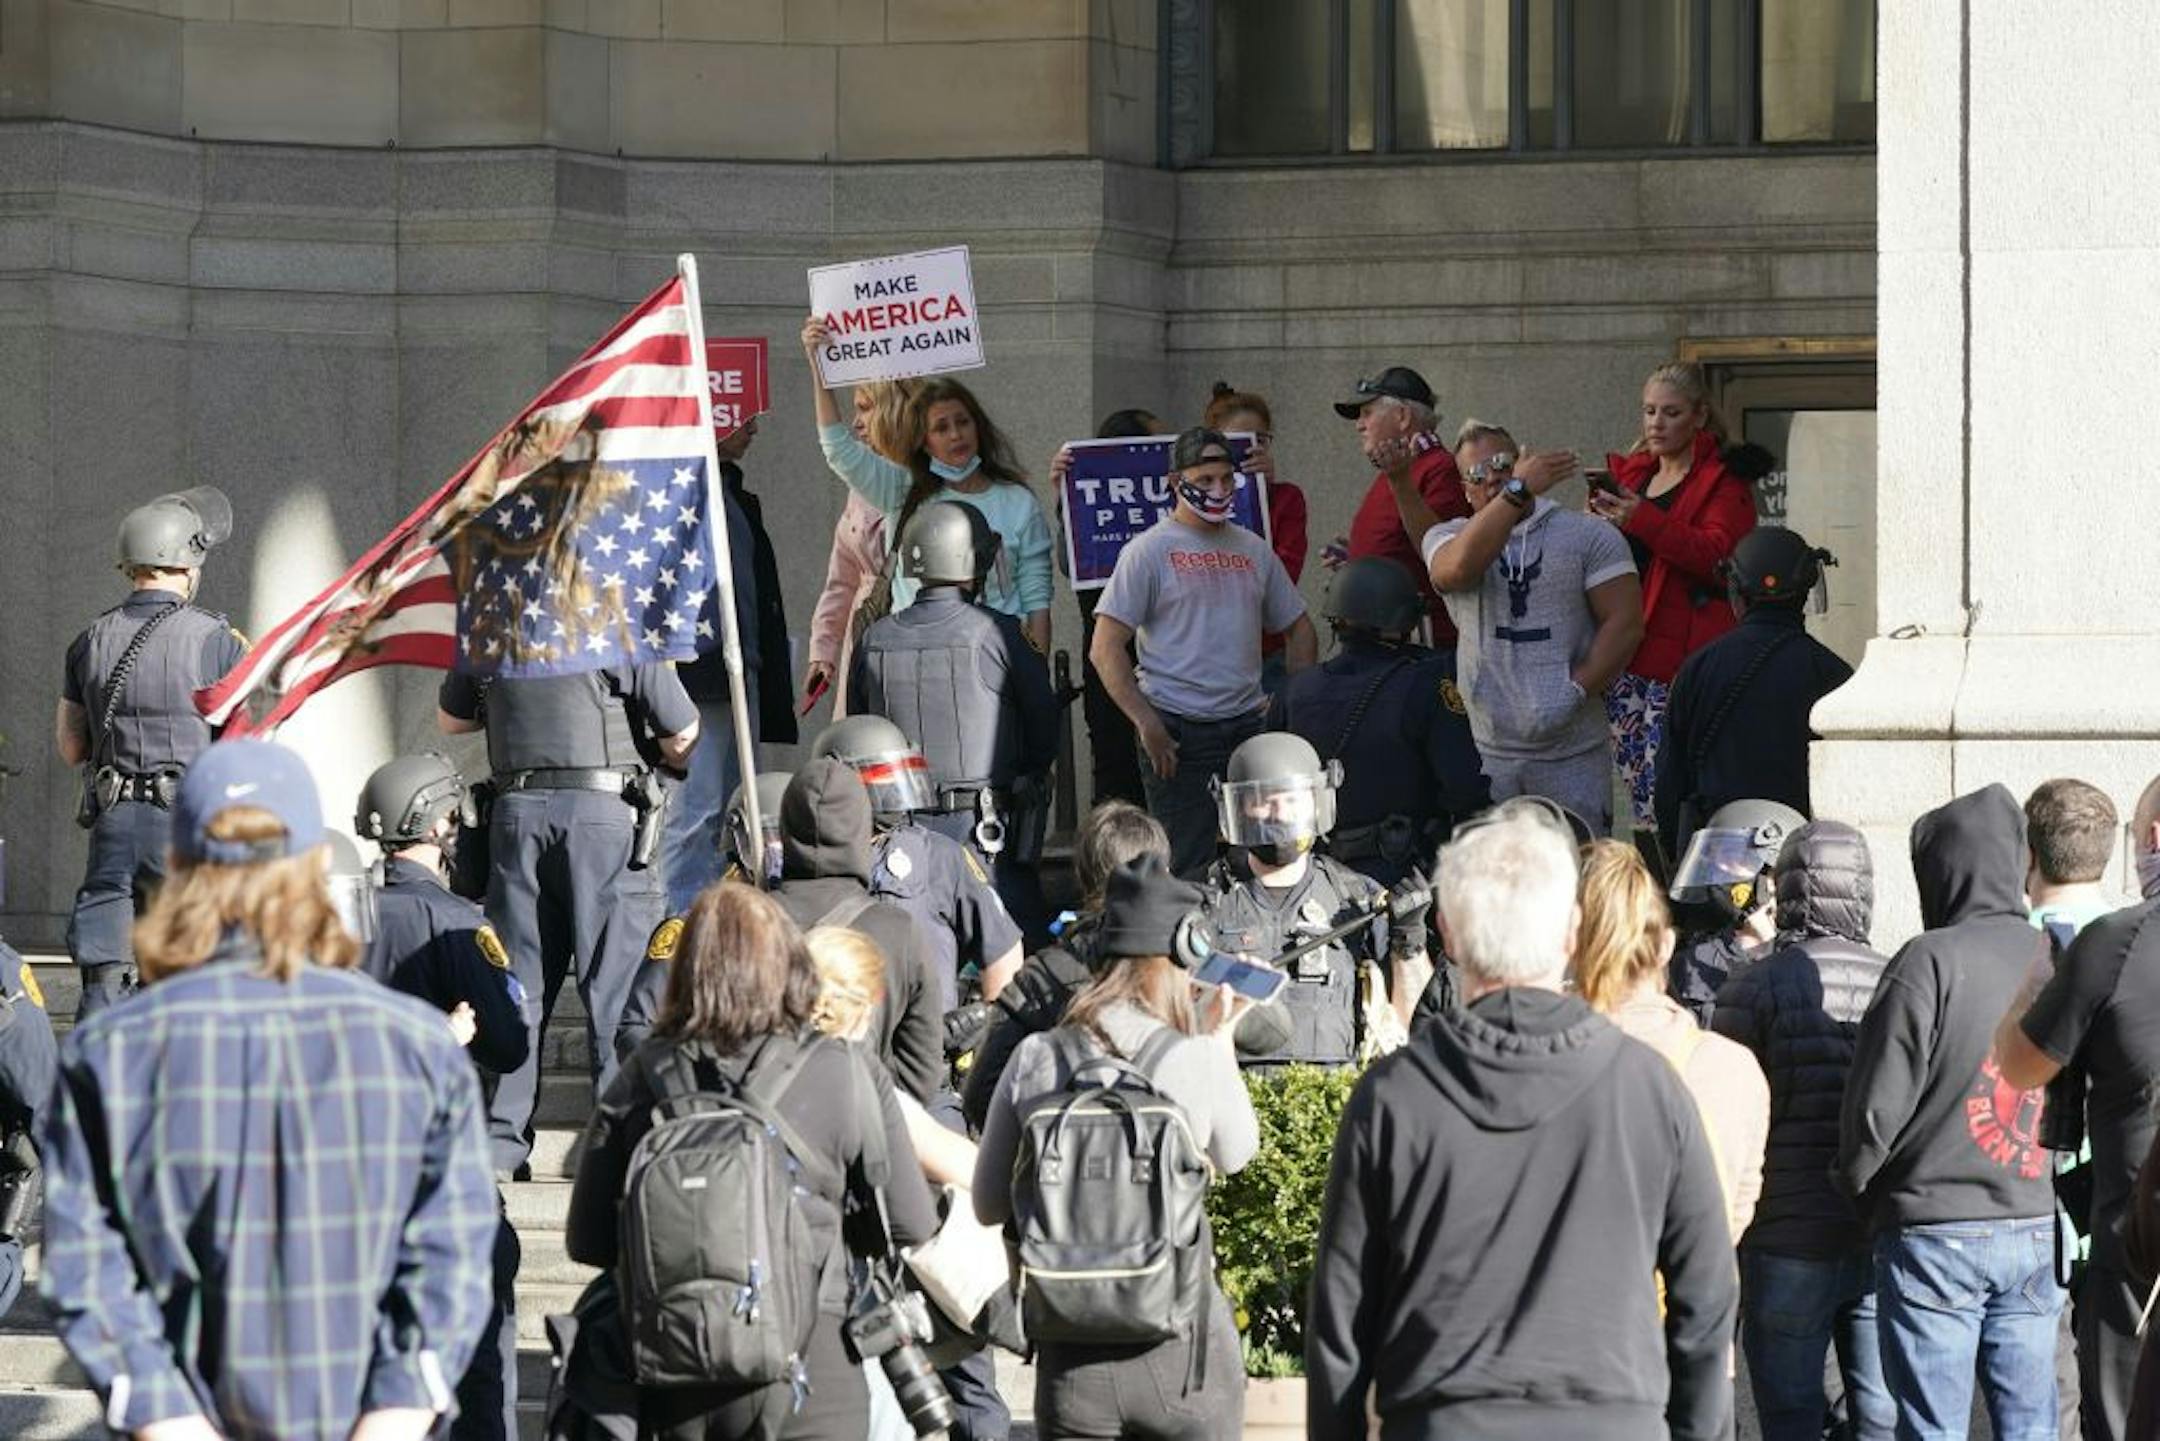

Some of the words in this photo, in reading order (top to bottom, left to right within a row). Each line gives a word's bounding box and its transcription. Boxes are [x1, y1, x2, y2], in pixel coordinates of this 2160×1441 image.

[854, 274, 918, 300] MAKE
[824, 294, 967, 336] AMERICA
[826, 338, 892, 362] GREAT
[900, 327, 971, 353] AGAIN
[1966, 1096, 2019, 1166] BURN
